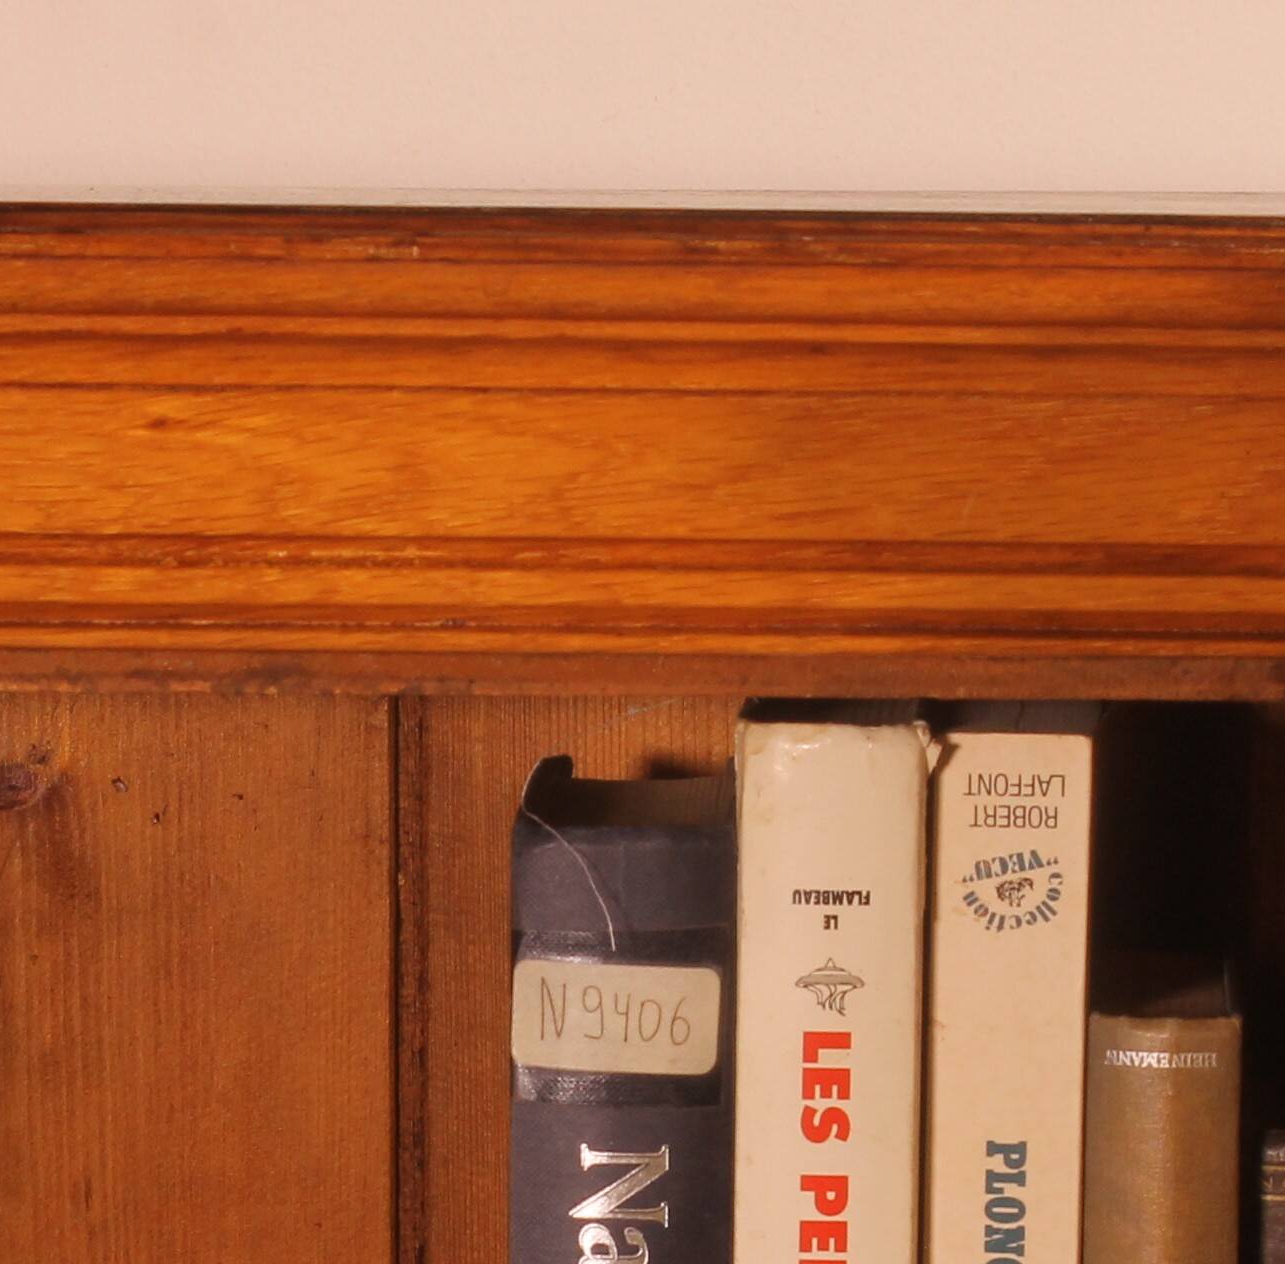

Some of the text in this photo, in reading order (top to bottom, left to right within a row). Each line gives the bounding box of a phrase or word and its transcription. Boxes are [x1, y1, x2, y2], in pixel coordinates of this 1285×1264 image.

[963, 773, 1065, 797] LAFFONT
[969, 805, 1058, 829] ROBERT
[792, 889, 871, 906] FLAMBEAU
[962, 872, 1064, 932] collection
[823, 914, 839, 930] LE
[1104, 1050, 1217, 1068] HEINEMANN
[800, 1031, 852, 1143] LES
